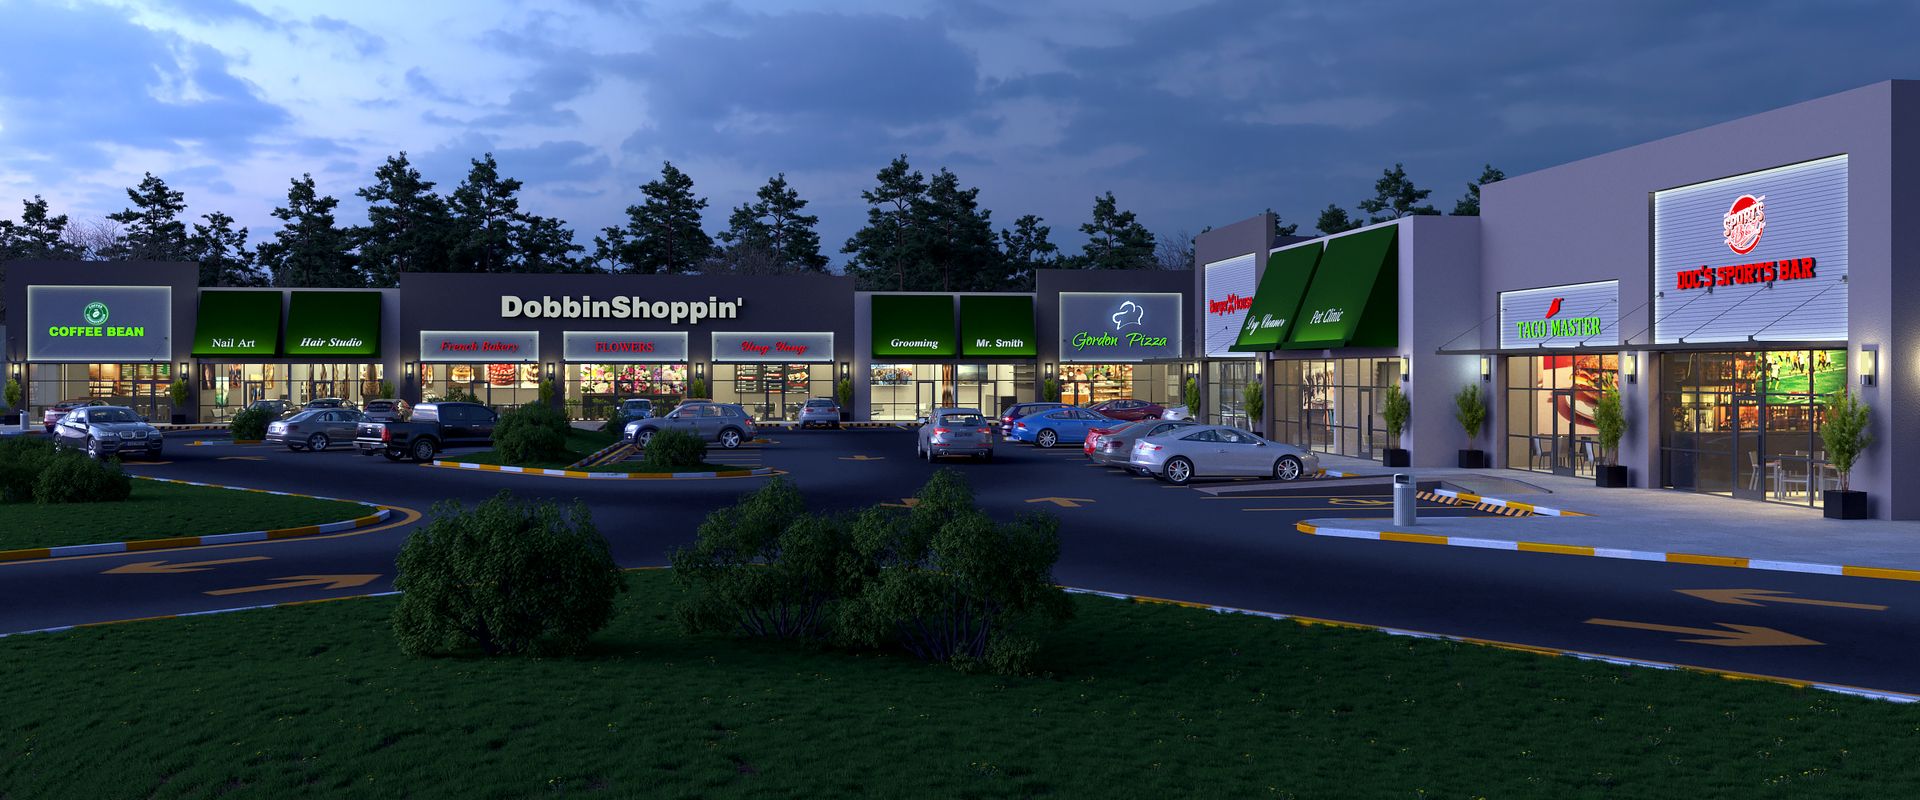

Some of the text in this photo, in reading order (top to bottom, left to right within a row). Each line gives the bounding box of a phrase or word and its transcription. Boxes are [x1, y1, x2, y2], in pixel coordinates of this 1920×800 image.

[1724, 202, 1765, 236] SPORTS
[1677, 257, 1815, 290] DOC'S SPORTS BAR
[501, 295, 743, 324] DobbinShoppin'
[1210, 295, 1253, 316] Burger House
[1310, 308, 1344, 324] Pet Clinic
[49, 326, 144, 337] COFFEE BEAN
[1517, 316, 1601, 339] TACO MASTER
[212, 338, 255, 348] Nail Art
[300, 337, 362, 348] Hair Studio
[441, 340, 519, 353] French Bakery
[595, 341, 655, 353] FLOWERS
[890, 338, 939, 350] Grooming
[976, 338, 1024, 348] Mr. Smith
[1072, 332, 1168, 351] Gordon Pizza
